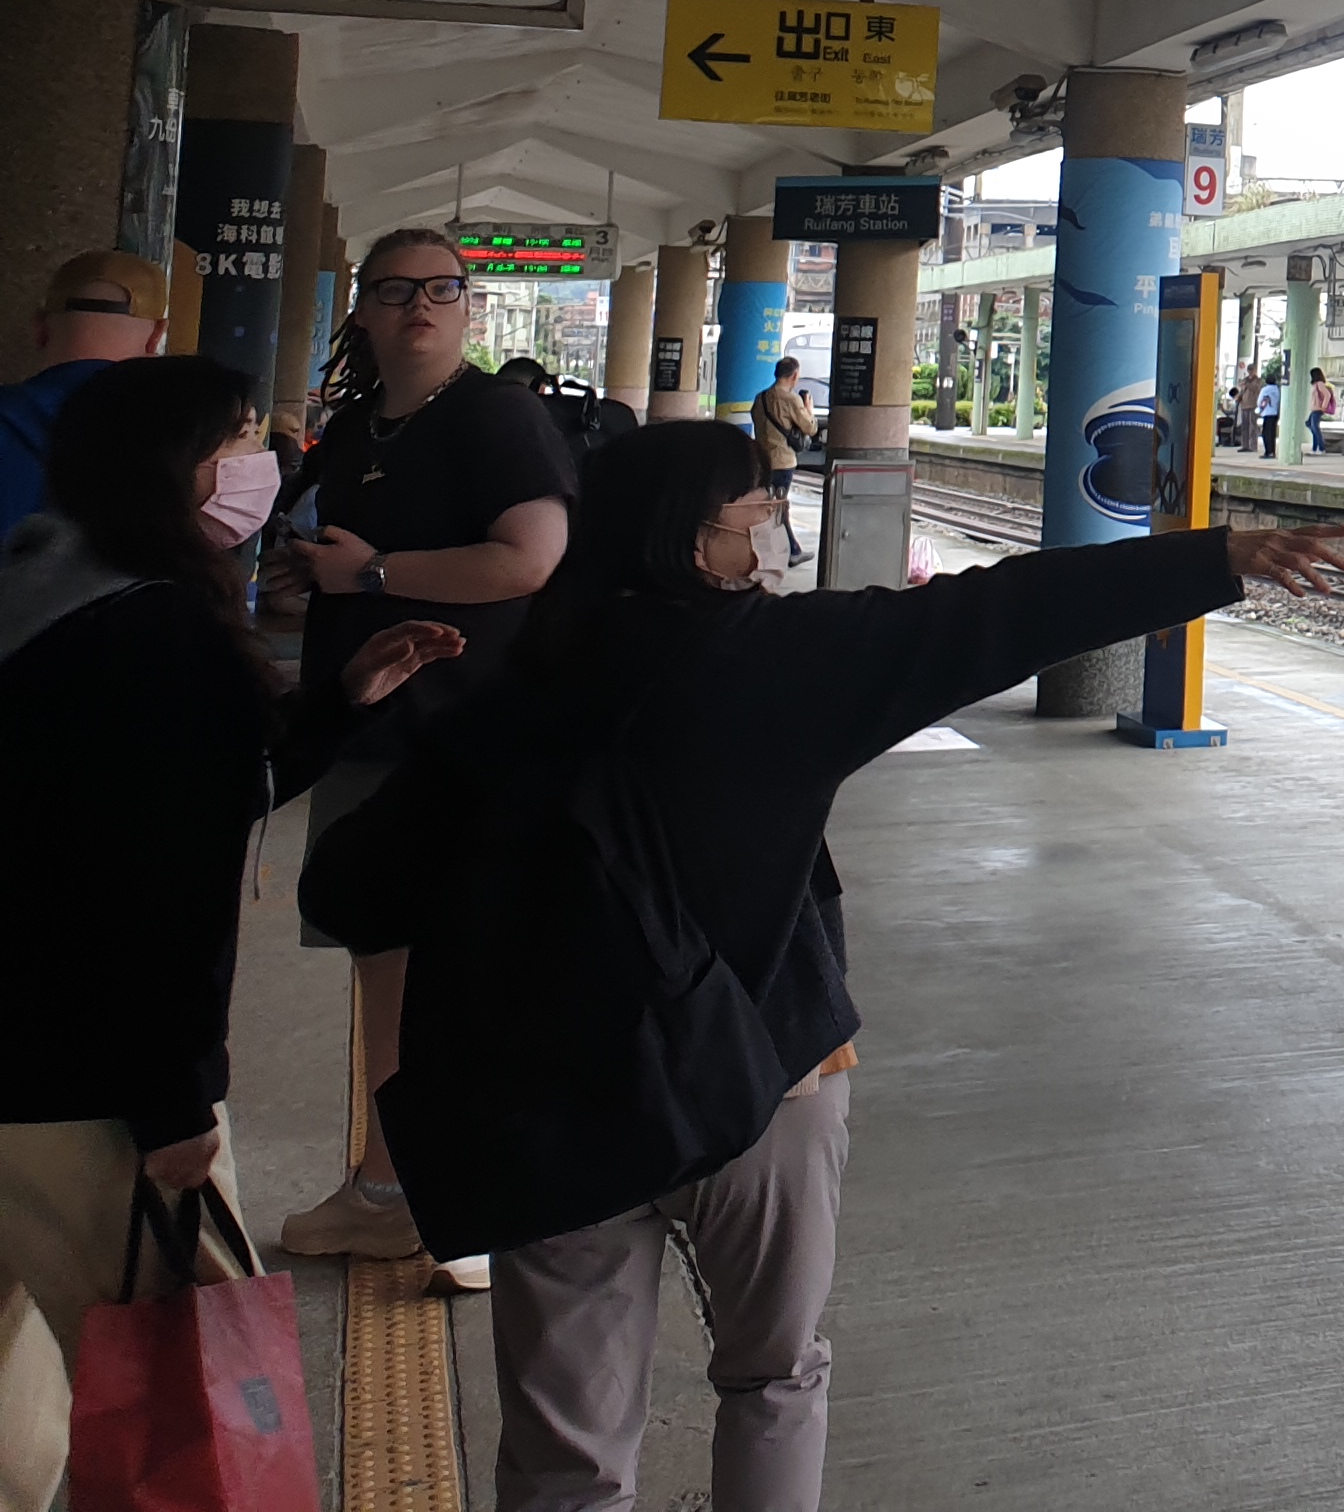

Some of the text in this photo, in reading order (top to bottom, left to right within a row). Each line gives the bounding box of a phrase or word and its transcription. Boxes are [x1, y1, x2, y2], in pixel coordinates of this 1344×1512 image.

[776, 9, 896, 60] 出口 東
[823, 46, 850, 62] Exit
[1191, 127, 1225, 146] 瑞芳
[1193, 165, 1217, 205] 9
[815, 194, 899, 216] 瑞芳車站
[804, 218, 908, 233] Ruifang Station
[595, 230, 610, 246] 3
